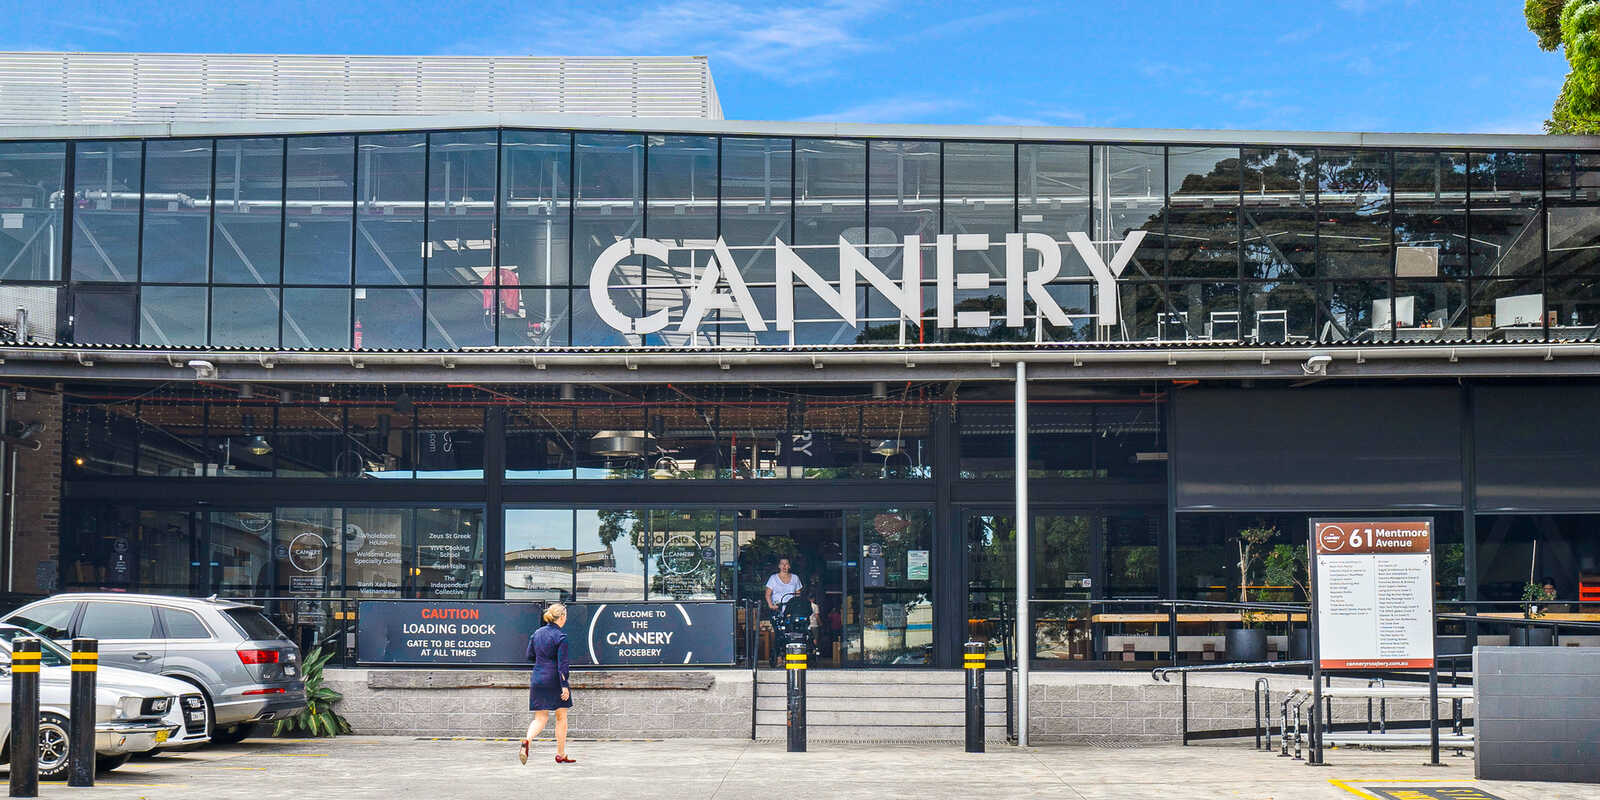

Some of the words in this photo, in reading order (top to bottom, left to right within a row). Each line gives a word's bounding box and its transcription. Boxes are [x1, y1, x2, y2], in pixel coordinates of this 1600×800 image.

[590, 231, 1147, 334] CANNERY
[1376, 529, 1428, 538] Mentmore
[1349, 529, 1373, 548] 61
[1376, 539, 1412, 547] Avenue
[421, 608, 479, 619] CAUTION
[403, 624, 457, 634] LOADING
[461, 624, 496, 635] DOCK
[632, 621, 648, 629] THE
[607, 632, 674, 645] CANNERY
[407, 640, 428, 648] GATE
[431, 640, 442, 648] TO
[445, 640, 455, 648] BE
[458, 640, 491, 648] CLOSED
[433, 649, 449, 657] ALL
[451, 649, 477, 657] TIMES
[619, 648, 662, 657] ROSEBERY
